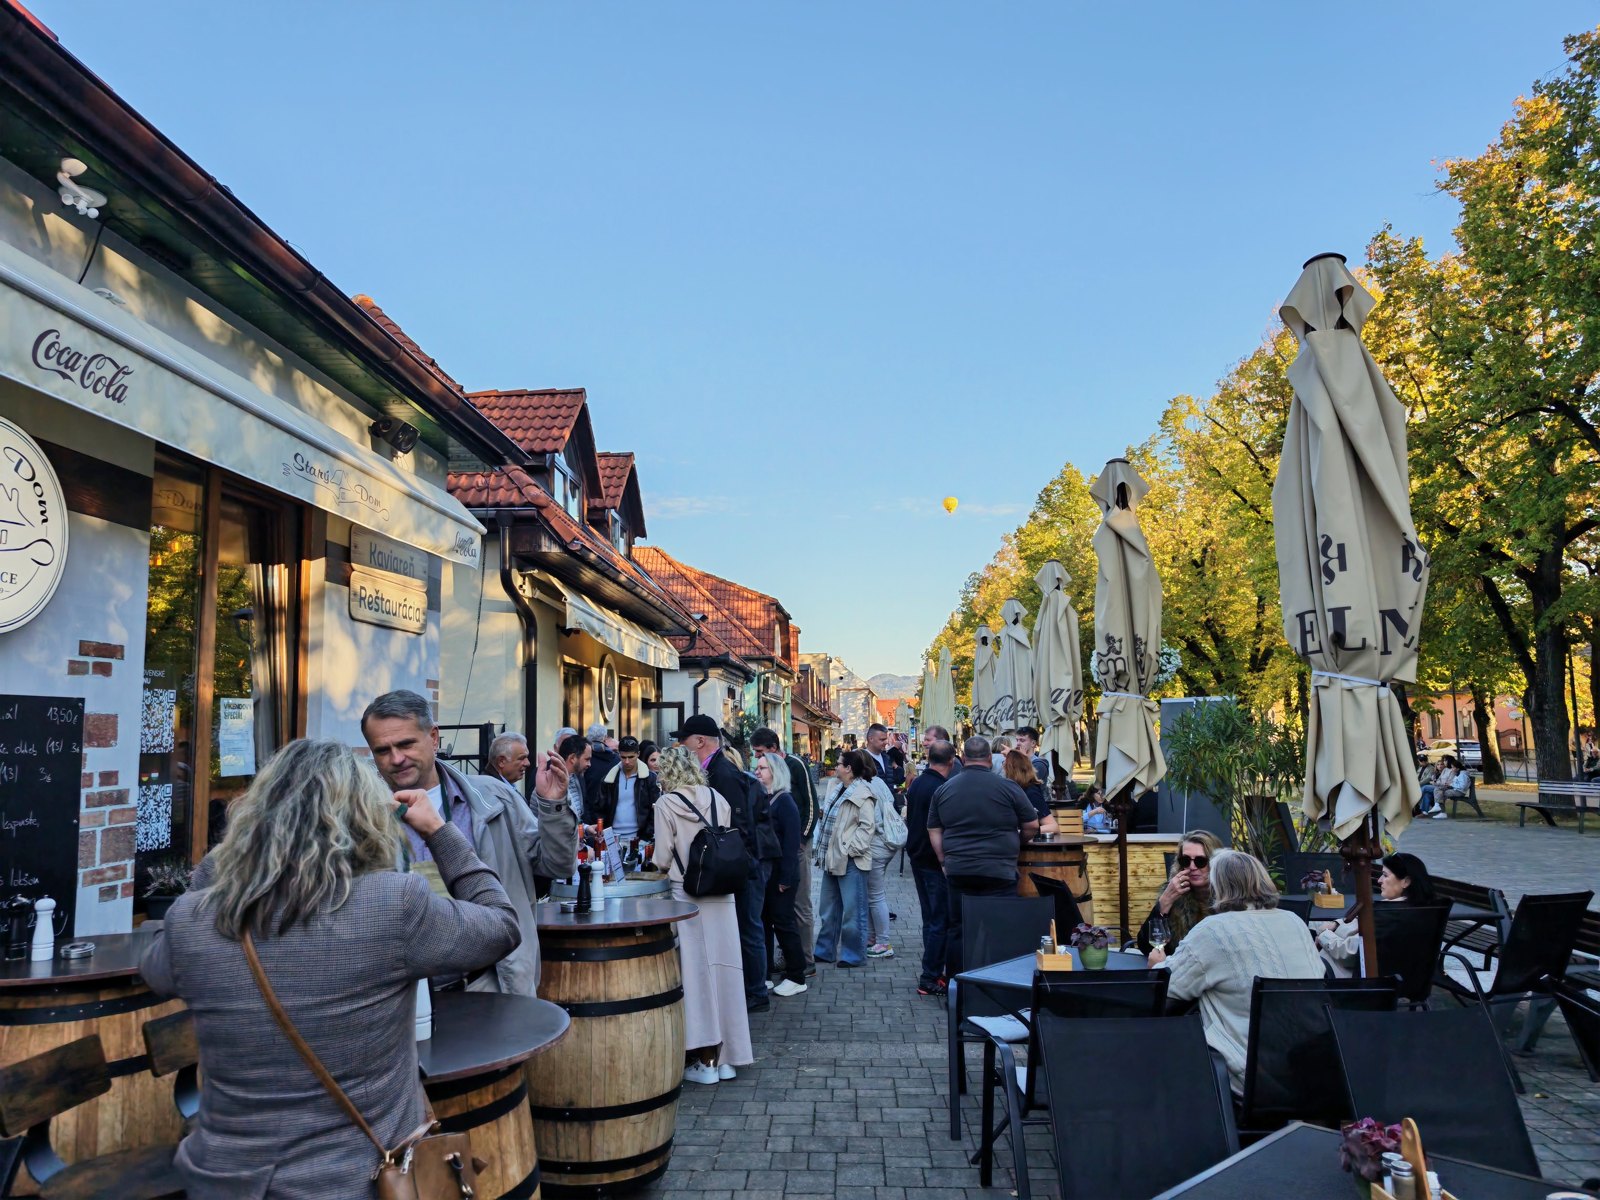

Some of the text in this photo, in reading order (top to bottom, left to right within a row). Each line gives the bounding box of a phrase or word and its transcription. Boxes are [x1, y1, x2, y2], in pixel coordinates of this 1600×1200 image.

[3, 446, 49, 525] Dom
[292, 452, 381, 508] Starý Dom
[368, 541, 415, 576] Kaviareň
[358, 584, 422, 623] Reštaurácia
